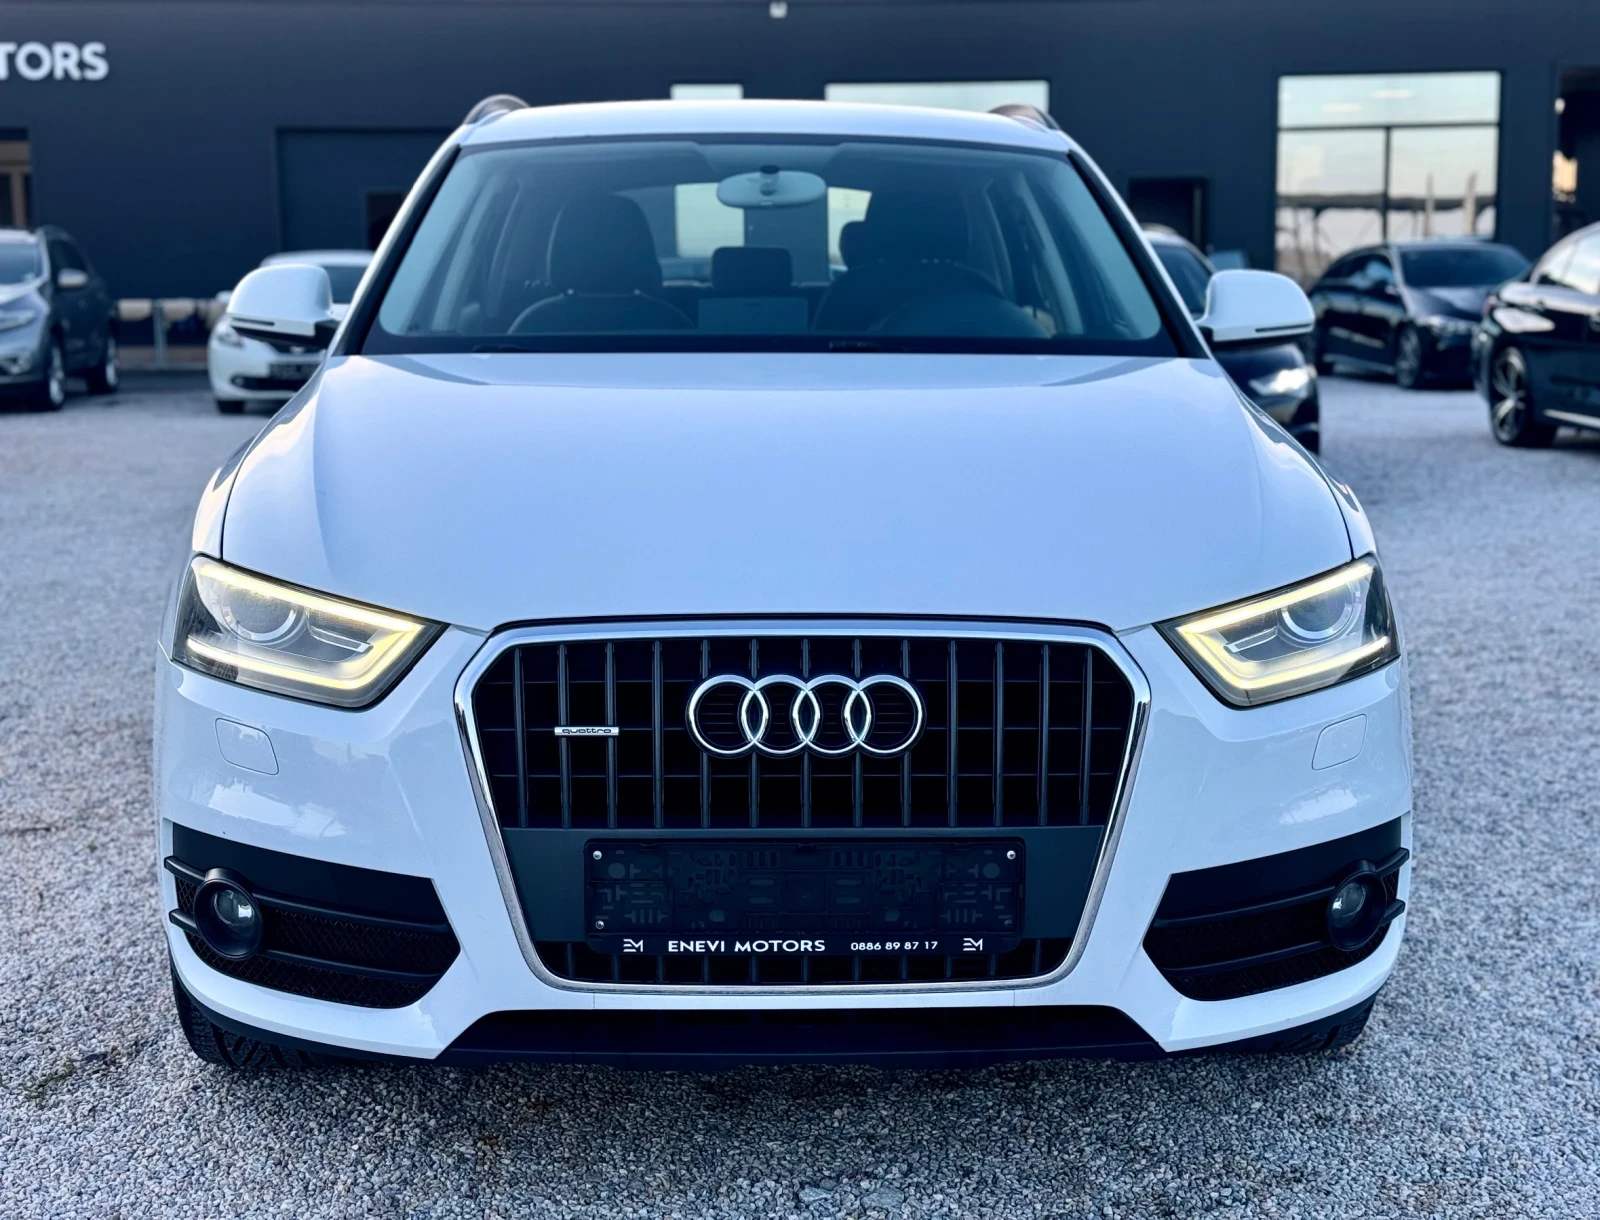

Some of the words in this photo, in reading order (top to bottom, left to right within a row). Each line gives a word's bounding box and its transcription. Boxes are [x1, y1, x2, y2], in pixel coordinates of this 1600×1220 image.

[560, 728, 613, 736] quattro
[667, 940, 725, 953] ENEVI
[733, 939, 826, 953] MOTORS
[850, 941, 882, 951] 0886
[884, 941, 901, 951] 89
[903, 941, 920, 951] 87
[924, 940, 939, 950] 17
